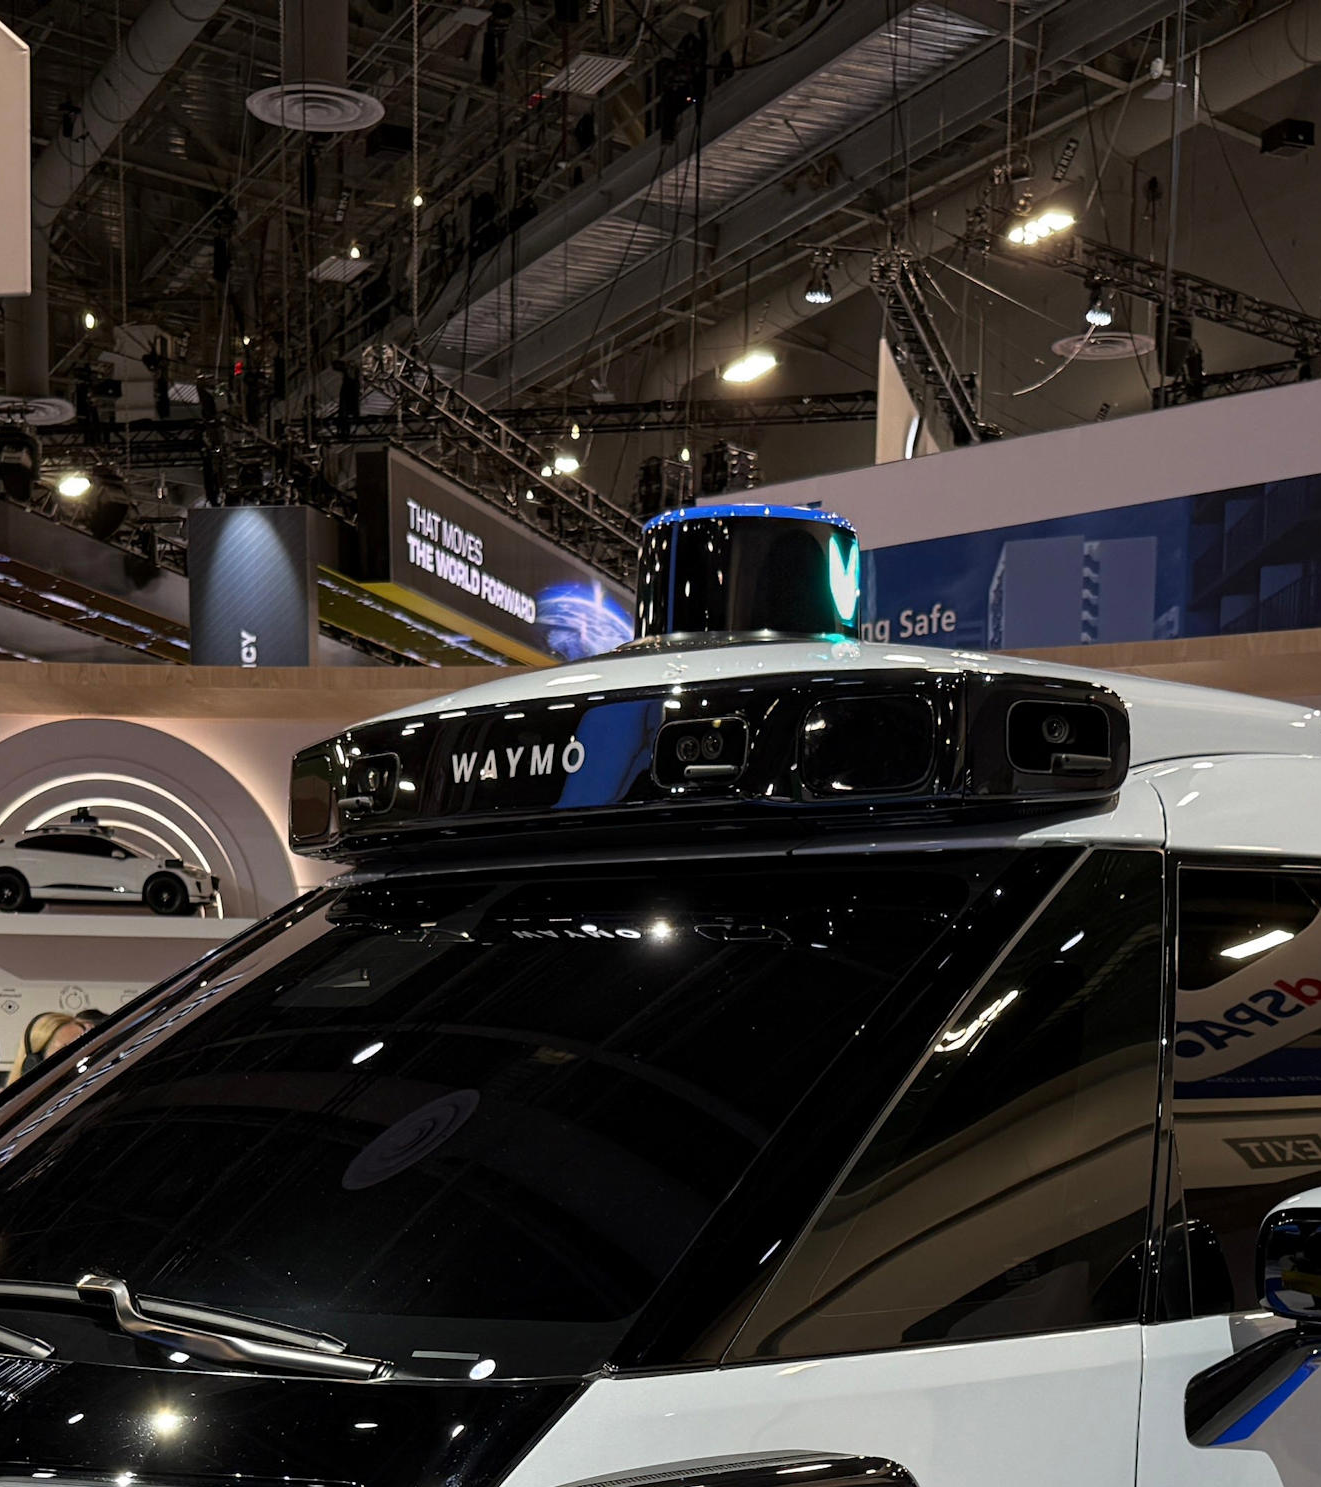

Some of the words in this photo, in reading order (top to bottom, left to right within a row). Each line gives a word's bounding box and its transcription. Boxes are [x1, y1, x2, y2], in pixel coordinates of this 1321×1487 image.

[406, 498, 441, 543] THAT
[441, 520, 483, 567] MOVES
[406, 533, 435, 574] THE
[435, 549, 481, 596] WORLD
[481, 572, 536, 625] FORWARD
[899, 603, 957, 639] Safe
[452, 740, 585, 784] WAYMO
